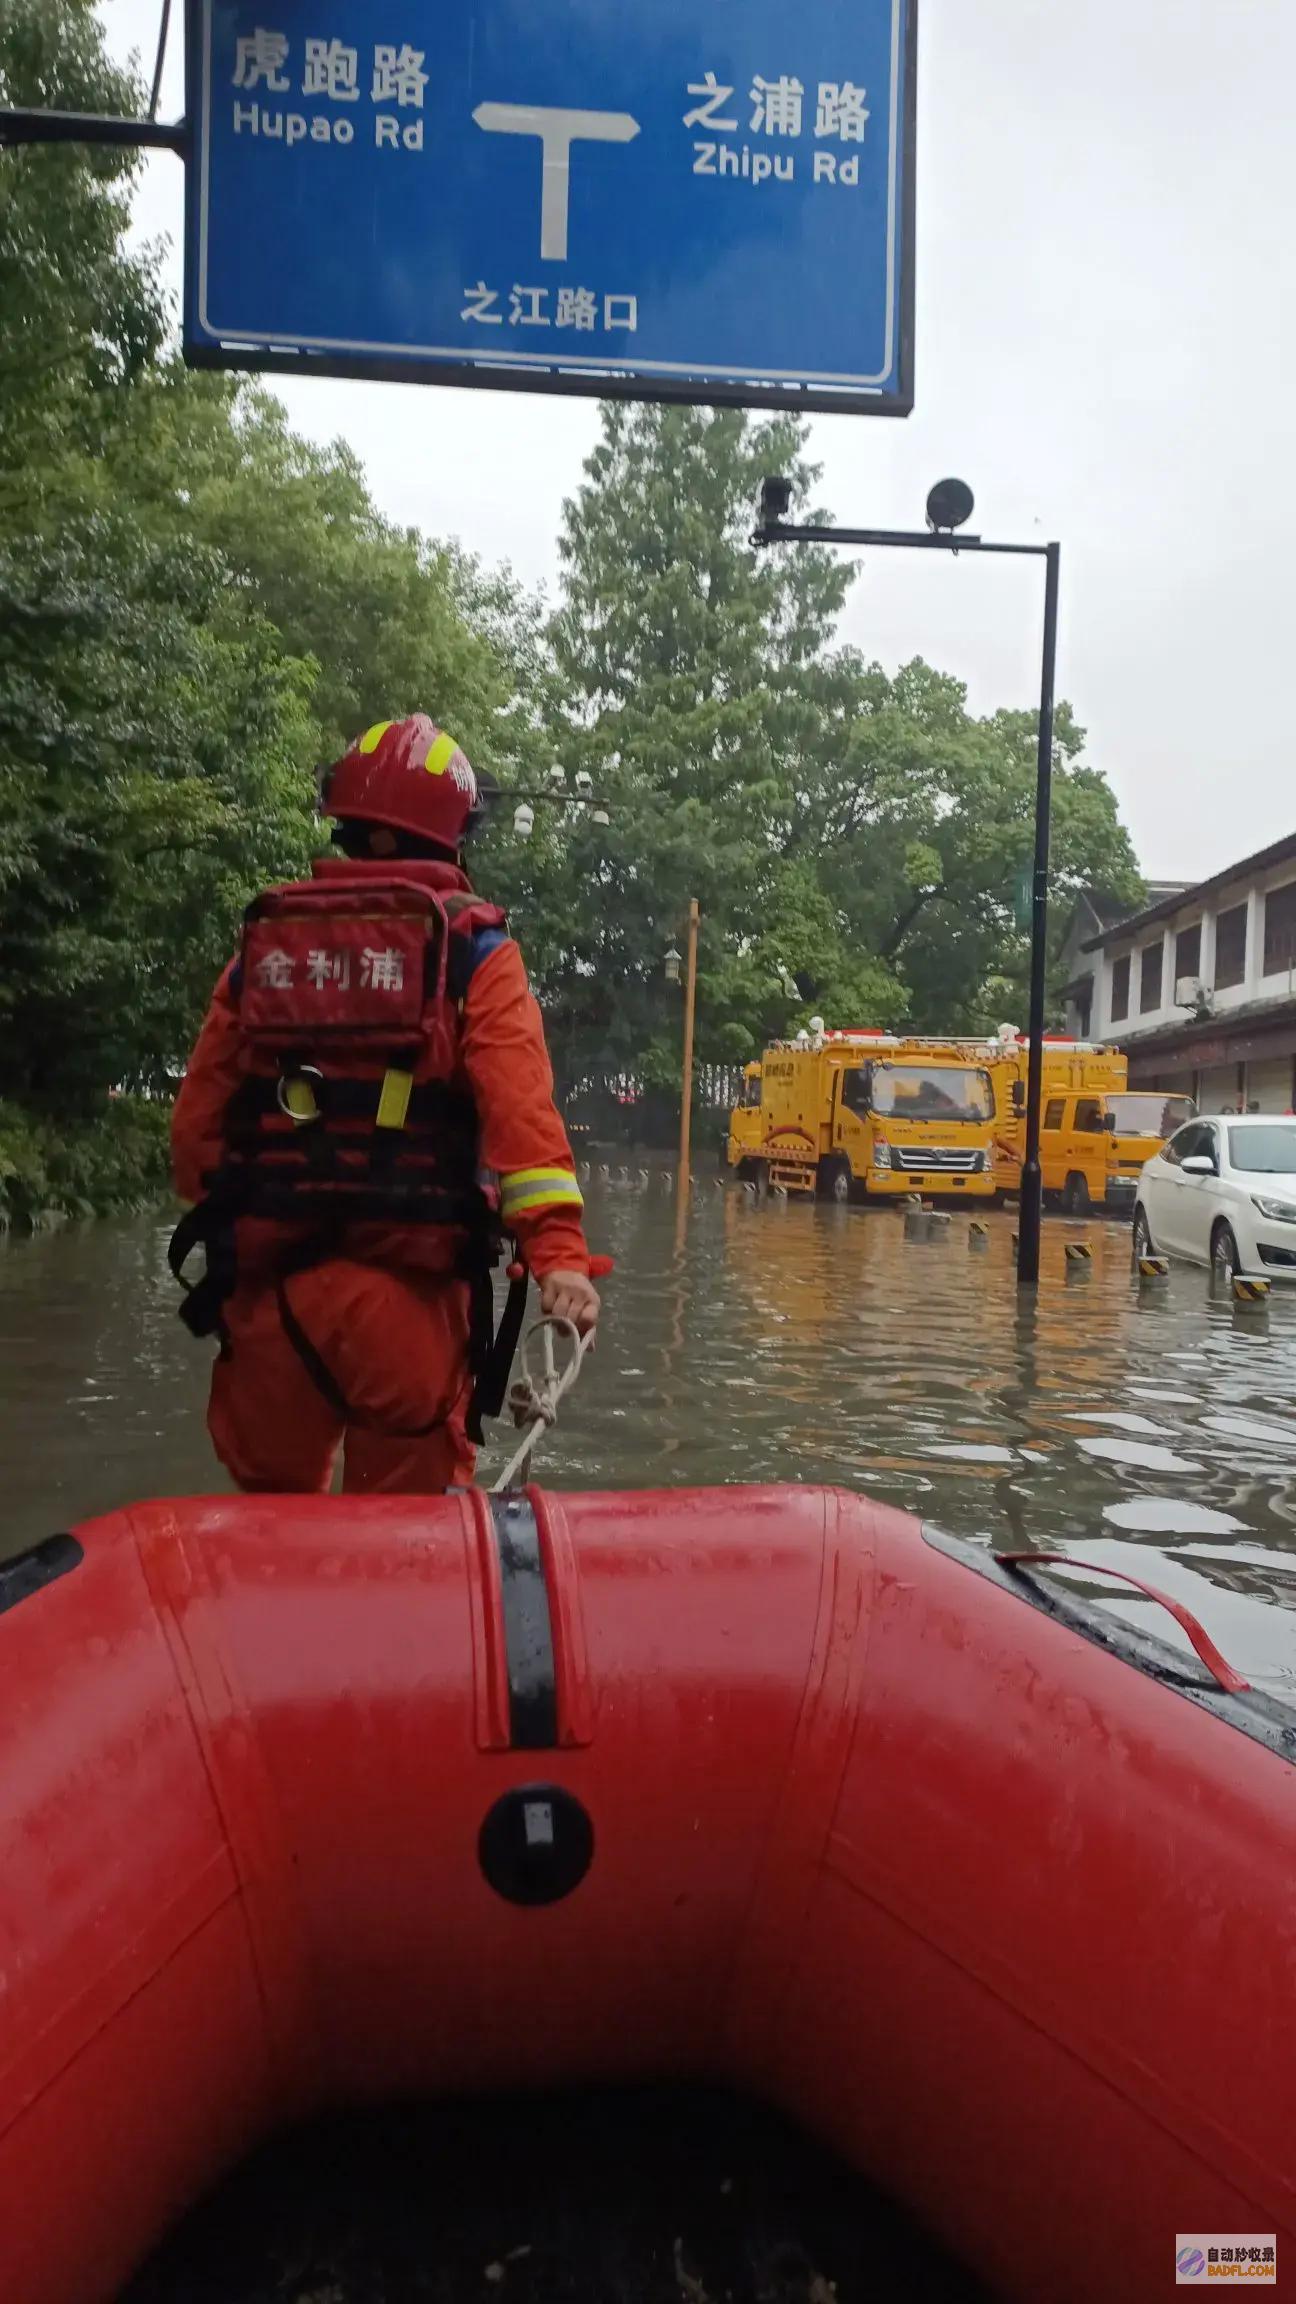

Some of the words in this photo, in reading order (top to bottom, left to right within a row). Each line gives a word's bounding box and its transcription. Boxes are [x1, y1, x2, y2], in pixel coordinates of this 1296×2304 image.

[231, 25, 430, 109] 虎跑路
[233, 99, 354, 146] Hupao
[375, 114, 424, 151] Rd
[682, 71, 870, 143] 之浦路
[692, 142, 794, 185] Zhipu
[813, 151, 859, 185] Rd
[460, 280, 638, 331] 之江路口
[256, 947, 406, 992] 金利浦
